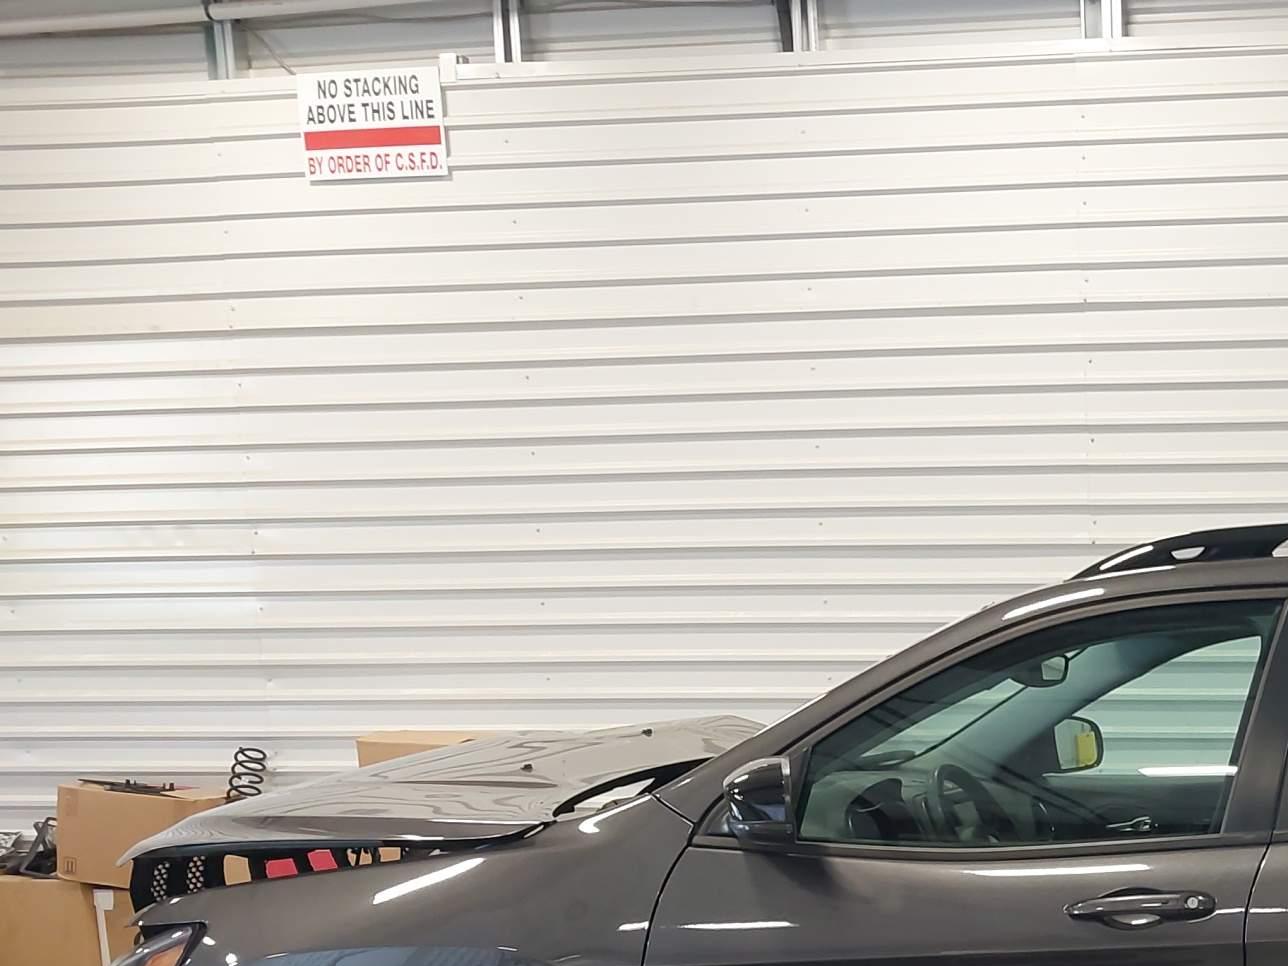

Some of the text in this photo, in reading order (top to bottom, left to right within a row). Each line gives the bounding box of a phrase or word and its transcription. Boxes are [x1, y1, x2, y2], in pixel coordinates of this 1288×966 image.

[317, 75, 419, 99] NO STACKING
[307, 99, 435, 124] ABOVE THIS LINE
[308, 157, 323, 175] BY
[328, 154, 371, 174] ORDER
[375, 153, 390, 172] OF
